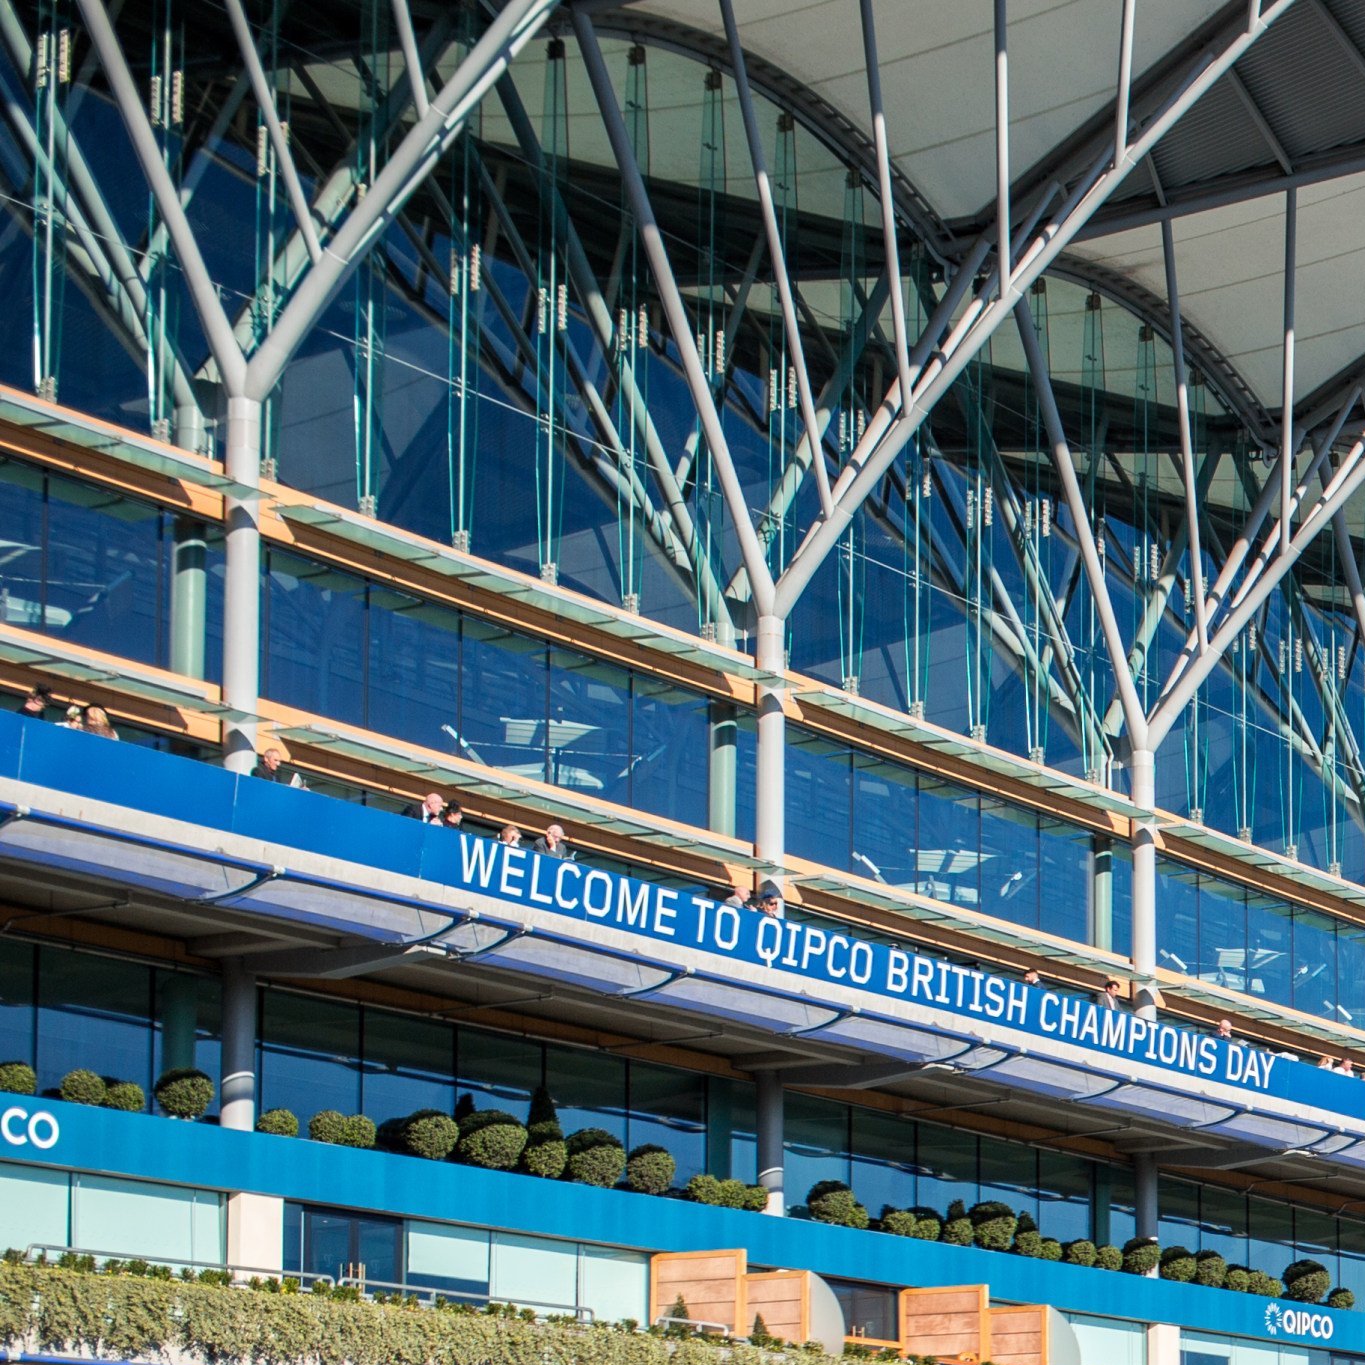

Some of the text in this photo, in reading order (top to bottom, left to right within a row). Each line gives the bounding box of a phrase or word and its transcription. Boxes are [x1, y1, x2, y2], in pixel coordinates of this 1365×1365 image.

[459, 833, 1276, 1090] WELCOME TO QIPCO BRITISH CHAMPIONS DAY
[1282, 1310, 1334, 1339] QIPCO
